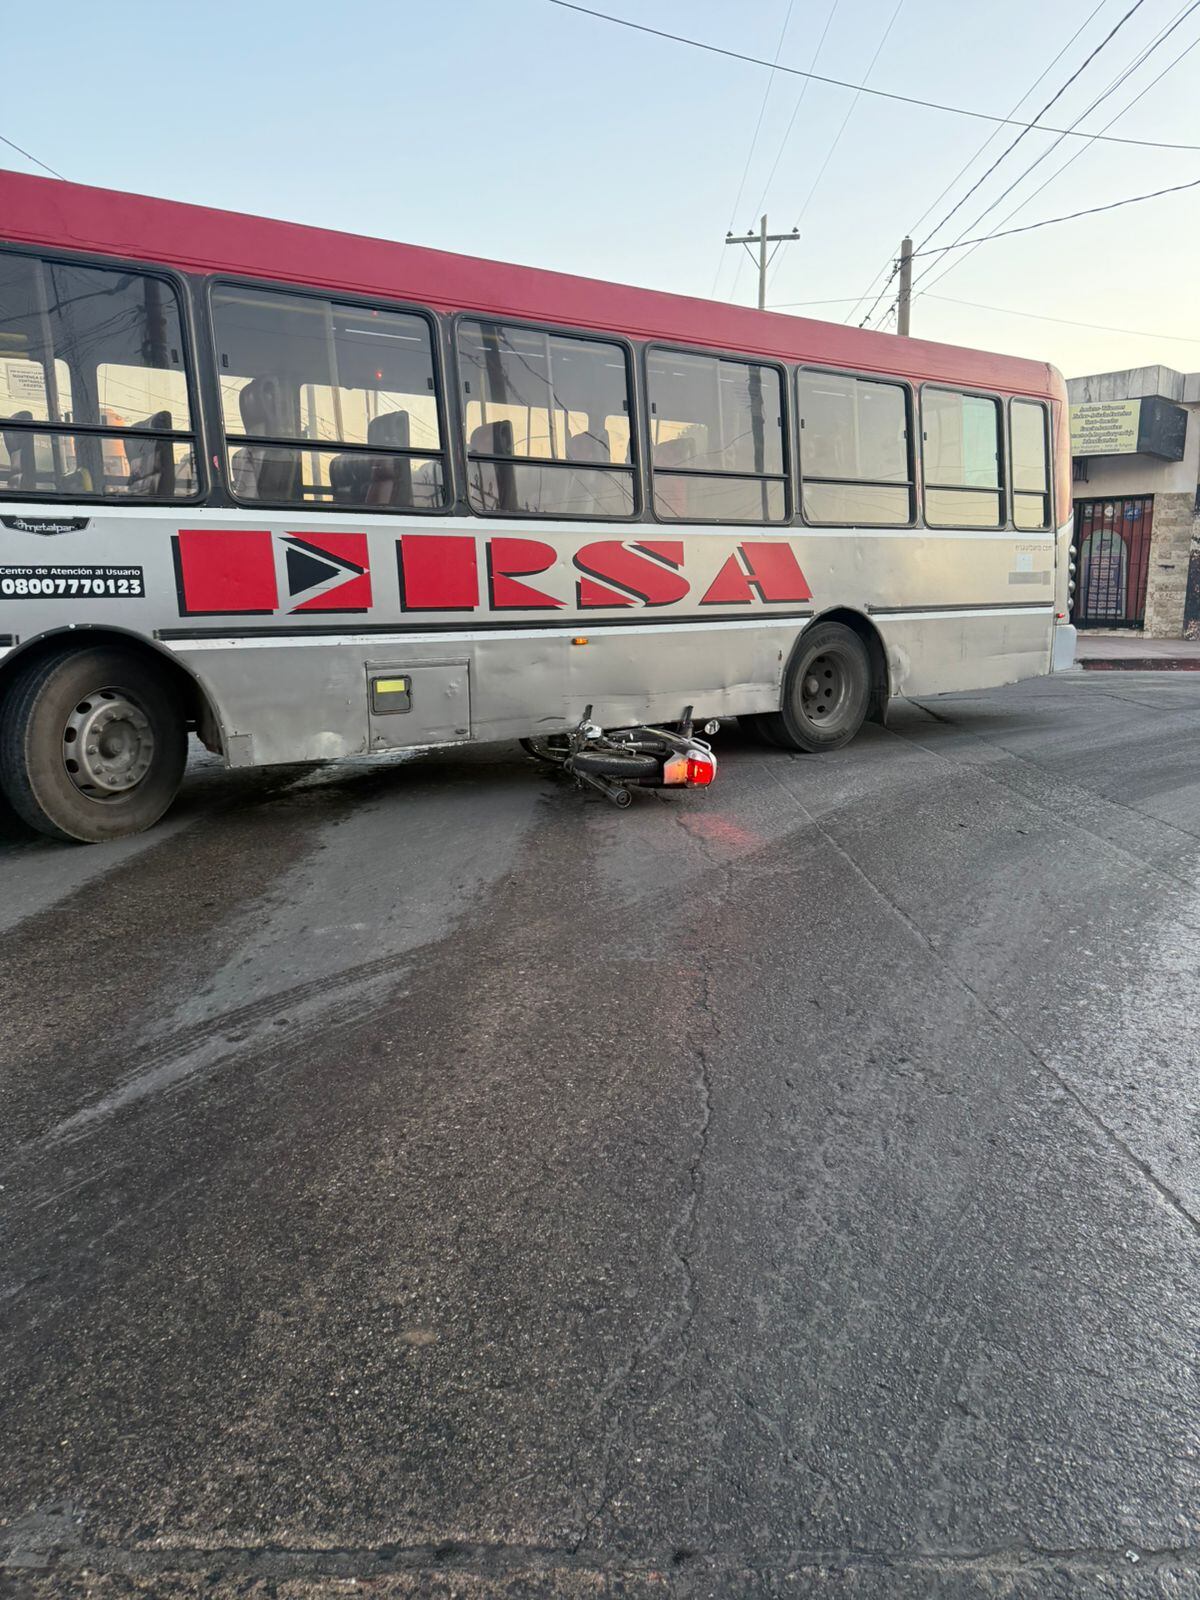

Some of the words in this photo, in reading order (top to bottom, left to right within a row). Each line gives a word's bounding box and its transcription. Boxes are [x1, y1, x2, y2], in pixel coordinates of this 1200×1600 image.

[25, 522, 75, 533] metalpar
[35, 567, 48, 575] de
[50, 567, 93, 576] Atención
[95, 568, 103, 576] al
[106, 568, 140, 576] Usuario
[1, 578, 141, 594] 08007770123
